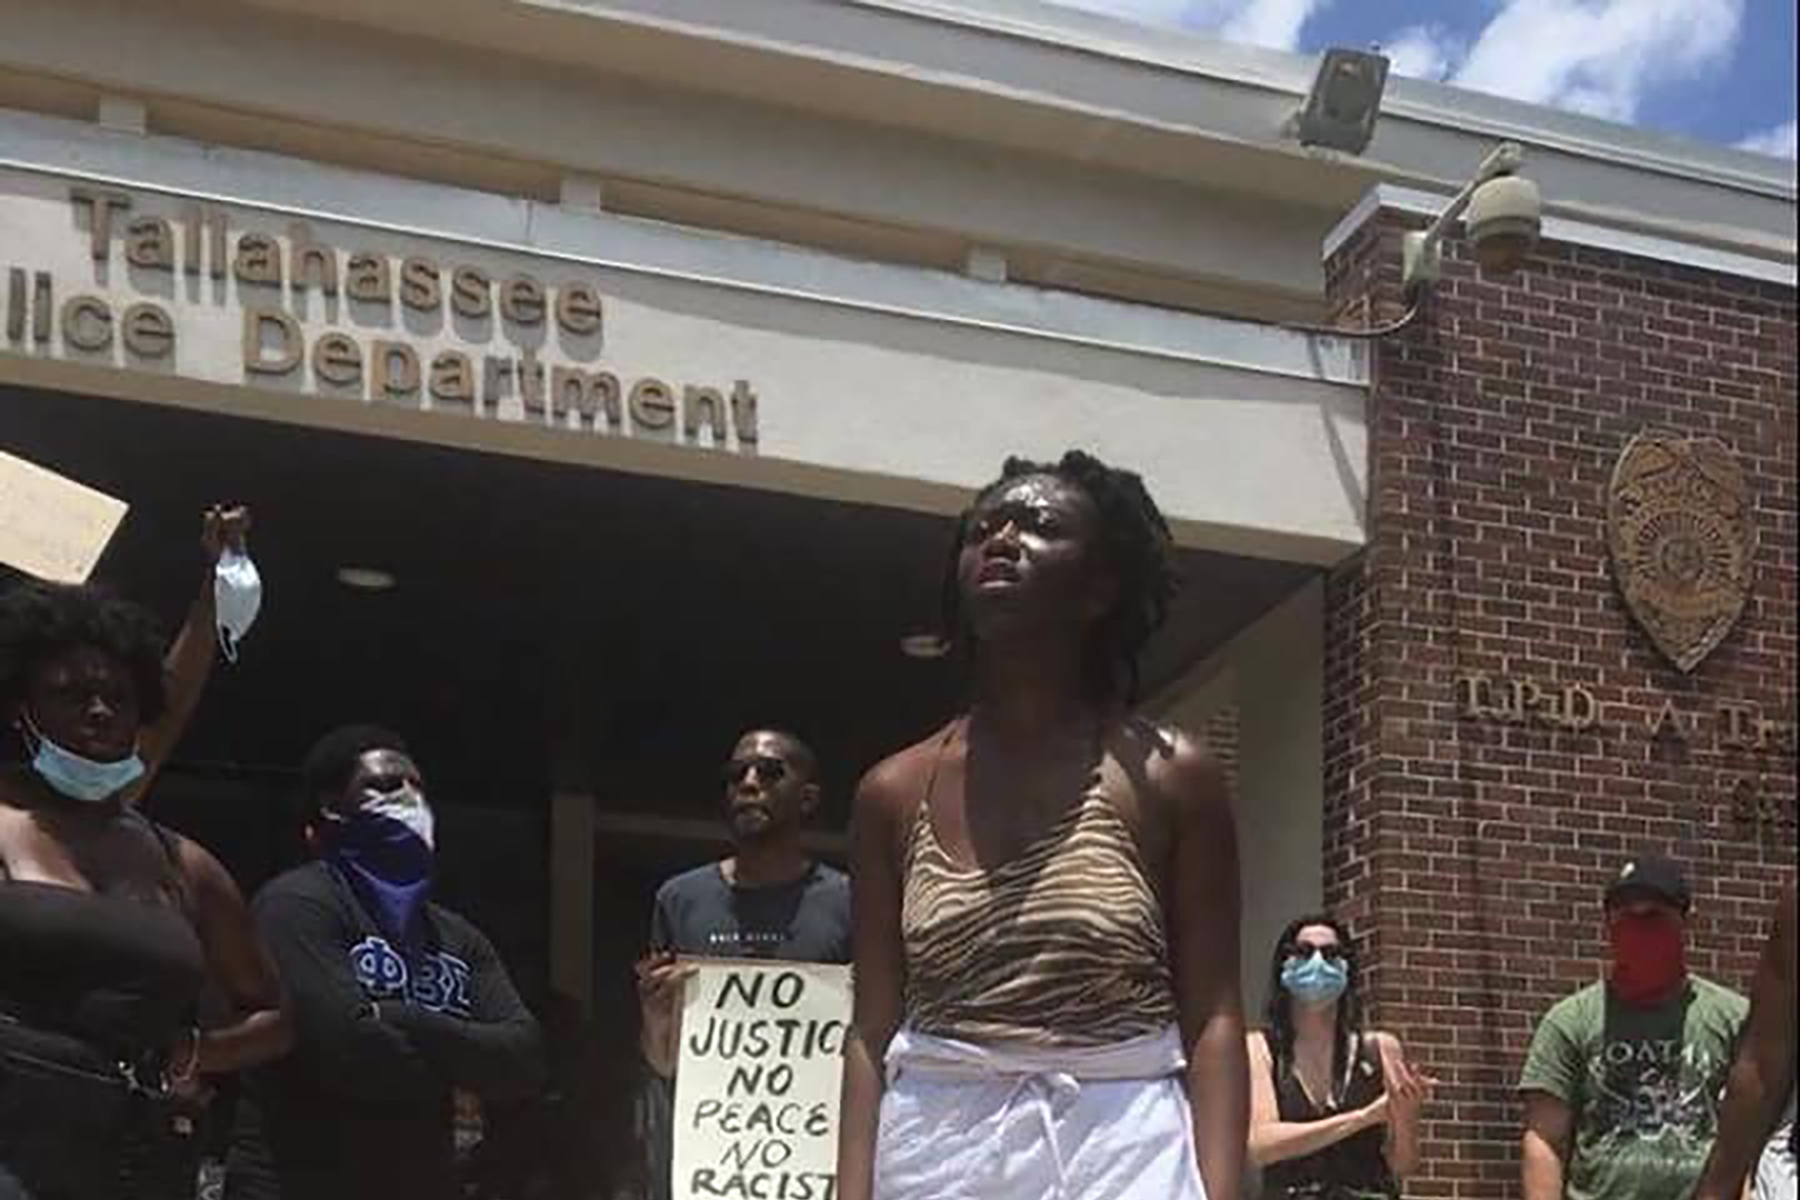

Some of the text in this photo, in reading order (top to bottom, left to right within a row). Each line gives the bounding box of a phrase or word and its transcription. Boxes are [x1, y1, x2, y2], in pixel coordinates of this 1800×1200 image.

[70, 186, 602, 334] Tallahassee
[243, 306, 759, 444] Department
[1651, 699, 1690, 737] A
[715, 971, 805, 1009] NO
[689, 1018, 846, 1060] JUSTIC
[727, 1063, 794, 1097] NO
[693, 1100, 829, 1135] PEACE
[719, 1140, 792, 1170] NO
